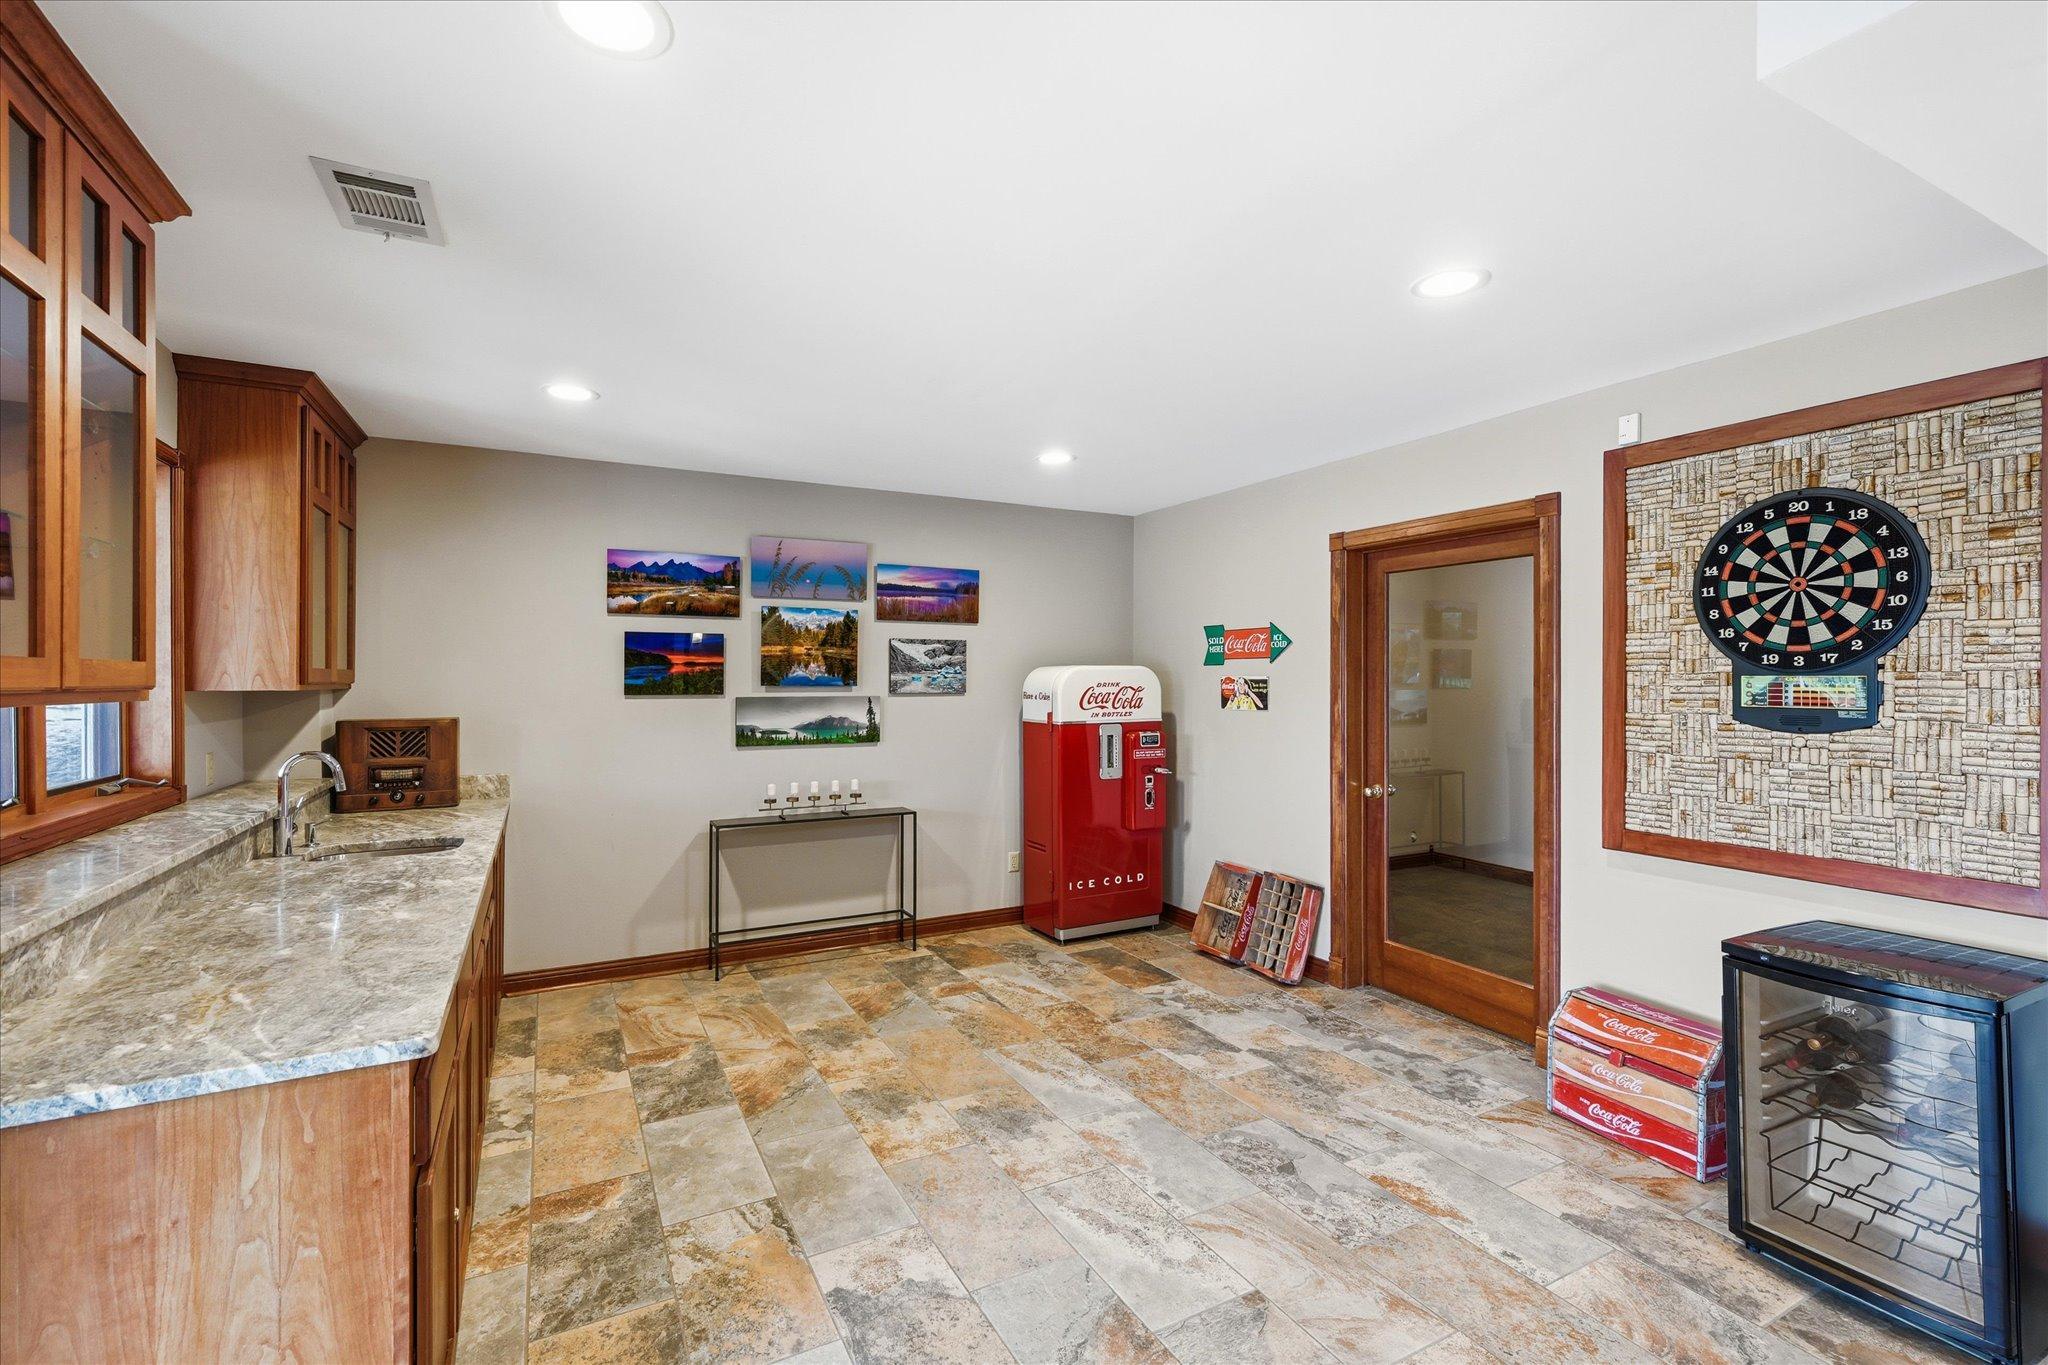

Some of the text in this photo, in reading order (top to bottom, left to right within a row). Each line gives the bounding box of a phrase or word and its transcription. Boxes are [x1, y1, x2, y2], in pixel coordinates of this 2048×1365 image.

[1788, 500, 1810, 512] 20
[1826, 501, 1834, 511] 1
[1764, 509, 1774, 519] 5
[1848, 508, 1868, 520] 18
[1736, 522, 1753, 534] 12
[1877, 525, 1889, 536] 4
[1719, 545, 1728, 554] 9
[1888, 547, 1909, 558] 13
[1704, 566, 1718, 576] 14
[1896, 571, 1908, 582] 6
[1702, 587, 1715, 596] 11
[1888, 593, 1908, 606] 10
[1709, 610, 1719, 619] 8
[1872, 619, 1893, 630] 15
[1273, 633, 1282, 641] ICE
[1718, 627, 1734, 638] 16
[1208, 637, 1224, 645] SOLD
[1225, 633, 1268, 654] Coca-Cola
[1739, 642, 1748, 651] 7
[1851, 640, 1863, 650] 2
[1209, 645, 1224, 653] HERE
[1761, 653, 1779, 664] 19
[1794, 656, 1804, 666] 3
[1820, 653, 1838, 664] 17
[1079, 685, 1145, 711] Coca-Cola
[1069, 872, 1144, 891] ICE COLD
[1603, 1018, 1661, 1044] Coca-Cola
[1591, 1063, 1644, 1094] Coca-Cola
[1588, 1103, 1643, 1136] Coca-Cola
